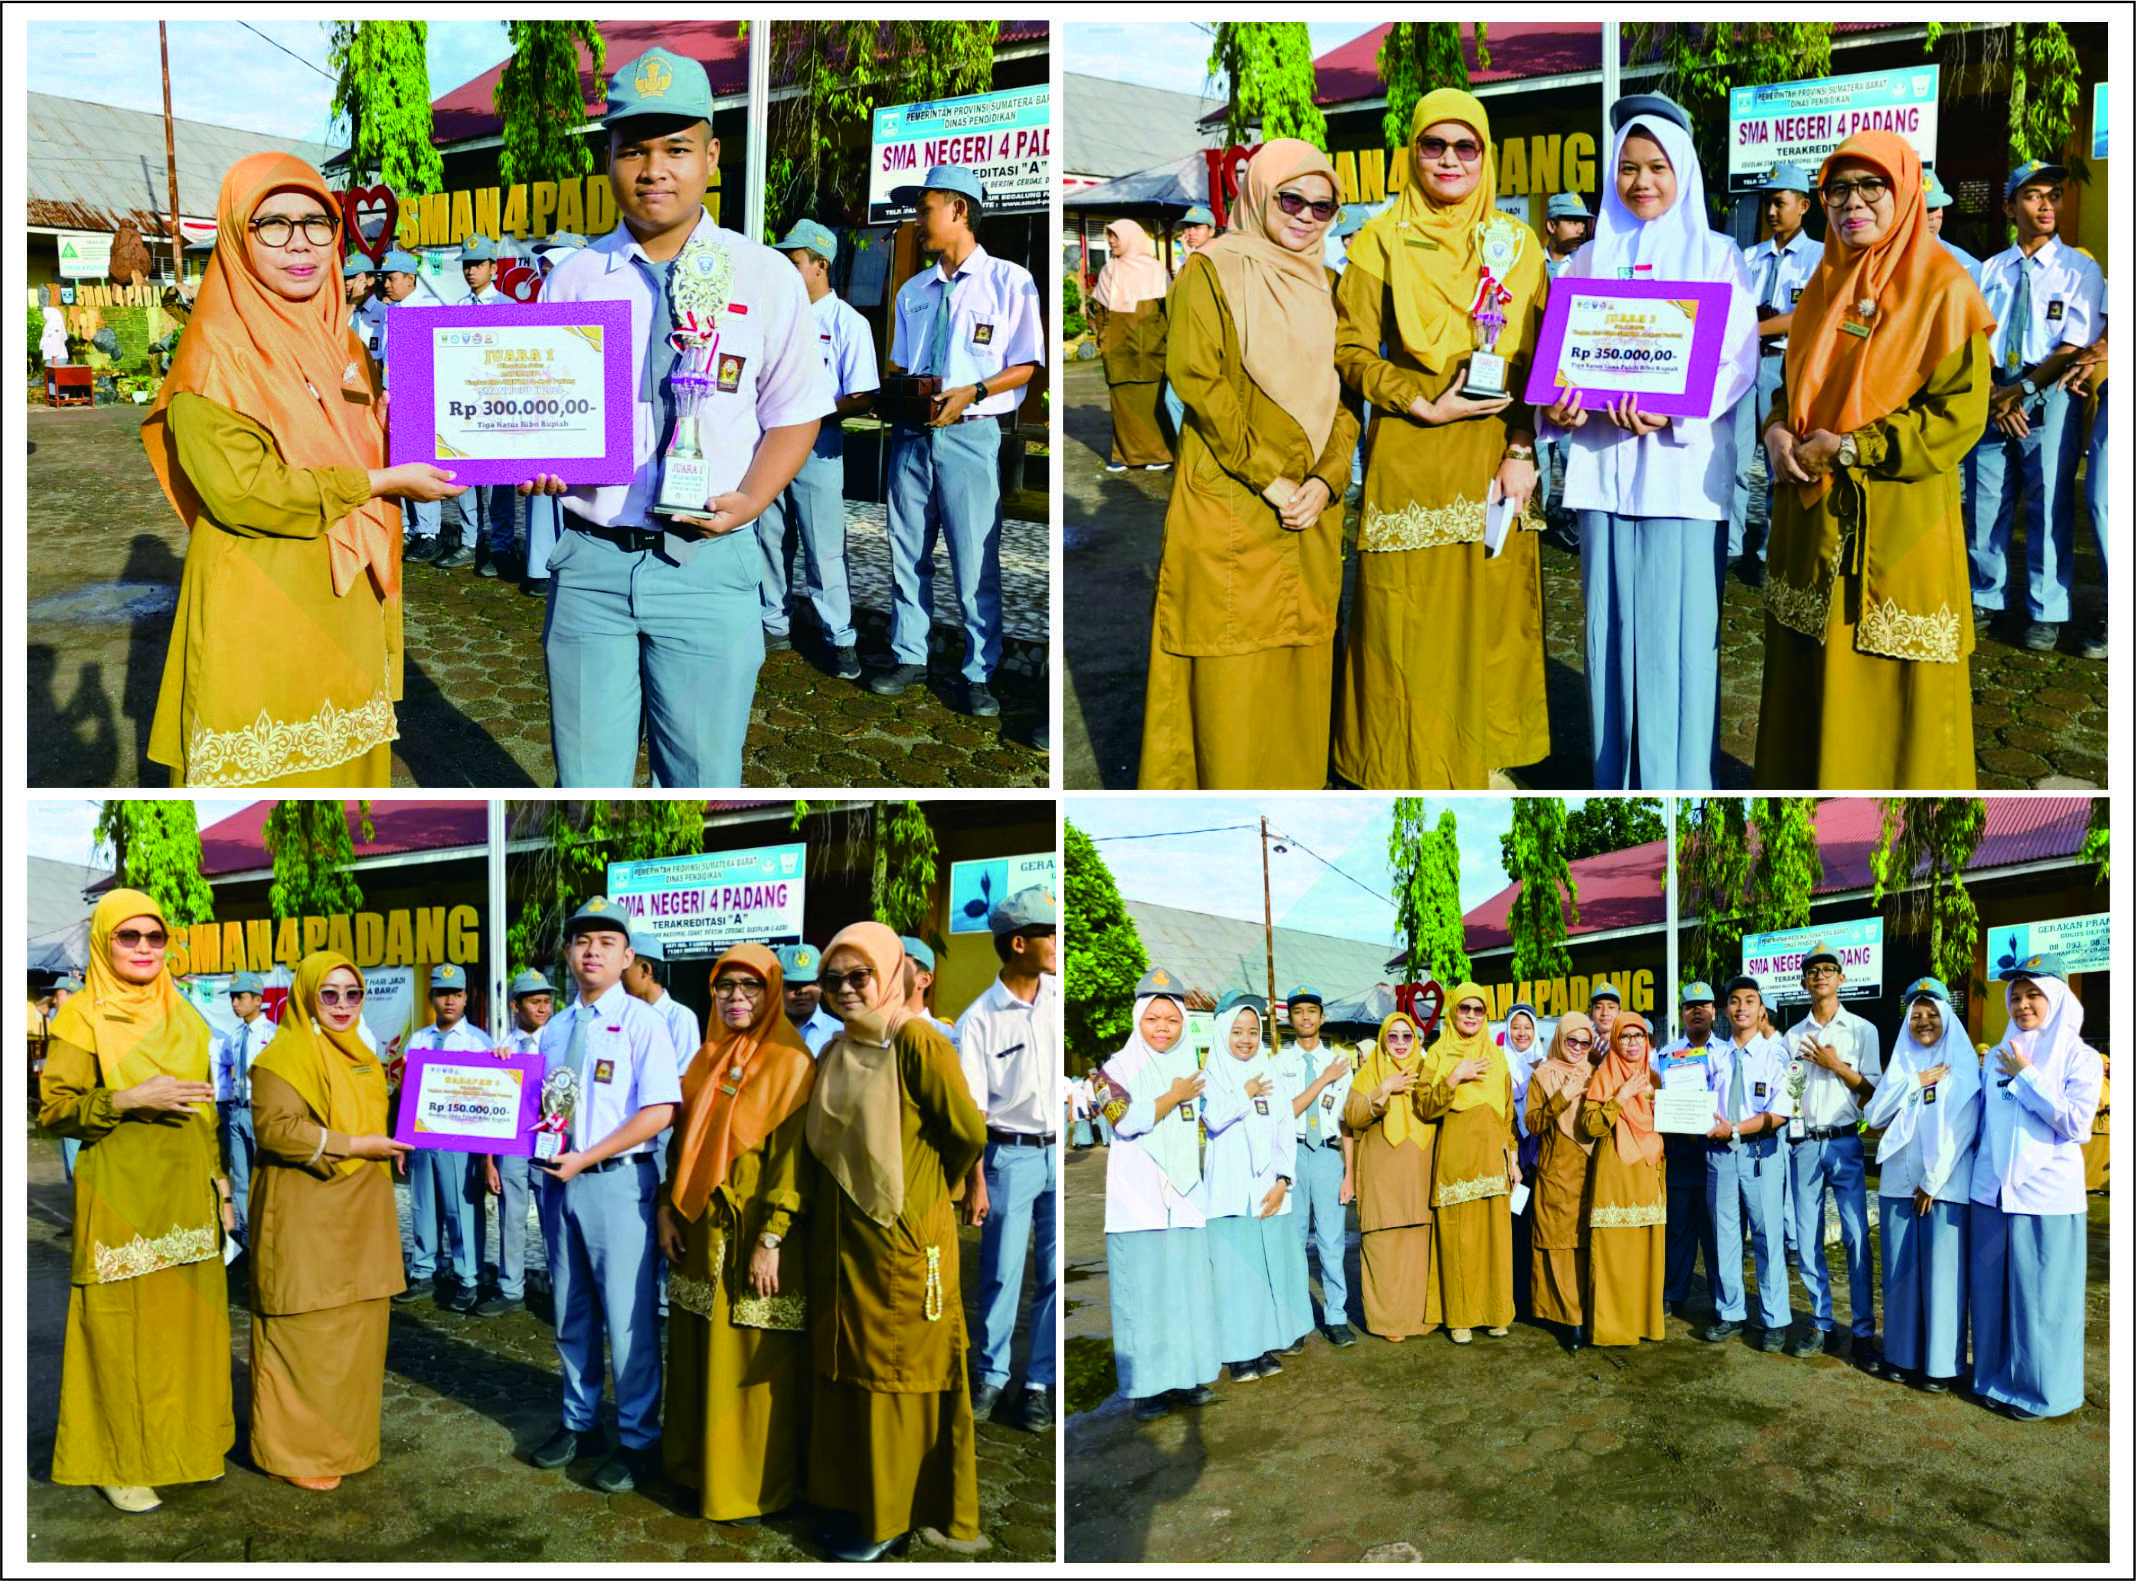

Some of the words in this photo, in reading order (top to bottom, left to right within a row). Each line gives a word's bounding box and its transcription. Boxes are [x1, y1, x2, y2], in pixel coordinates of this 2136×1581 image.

[954, 103, 989, 116] PROVINSI
[990, 98, 1033, 111] SUMATERA
[944, 117, 967, 128] DINAS
[968, 111, 1017, 125] PENDIDIKAN
[1739, 120, 1768, 145] SMA
[1775, 114, 1832, 142] NEGERI
[1837, 113, 1846, 138] 4
[1851, 107, 1919, 135] PADANG
[882, 143, 916, 172] SMA
[924, 134, 992, 168] NEGERI
[999, 132, 1009, 160] 4
[972, 167, 1018, 180] EDITASI
[518, 257, 530, 266] TH
[484, 349, 541, 364] JUARA
[546, 349, 555, 361] 1
[1571, 347, 1590, 360] Rp
[1594, 348, 1678, 362] 350.000,00-
[449, 401, 477, 420] Rp
[483, 399, 597, 417] 300.000,00-
[477, 421, 495, 429] Tiga
[541, 420, 569, 428] Rupiah
[651, 889, 705, 916] NEGERI
[710, 889, 718, 912] 4
[723, 883, 788, 910] PADANG
[652, 917, 726, 930] TERAKREDITASI
[1749, 957, 1769, 975] SMA
[428, 1102, 444, 1112] Rp
[448, 1104, 510, 1116] 150.000,00-
